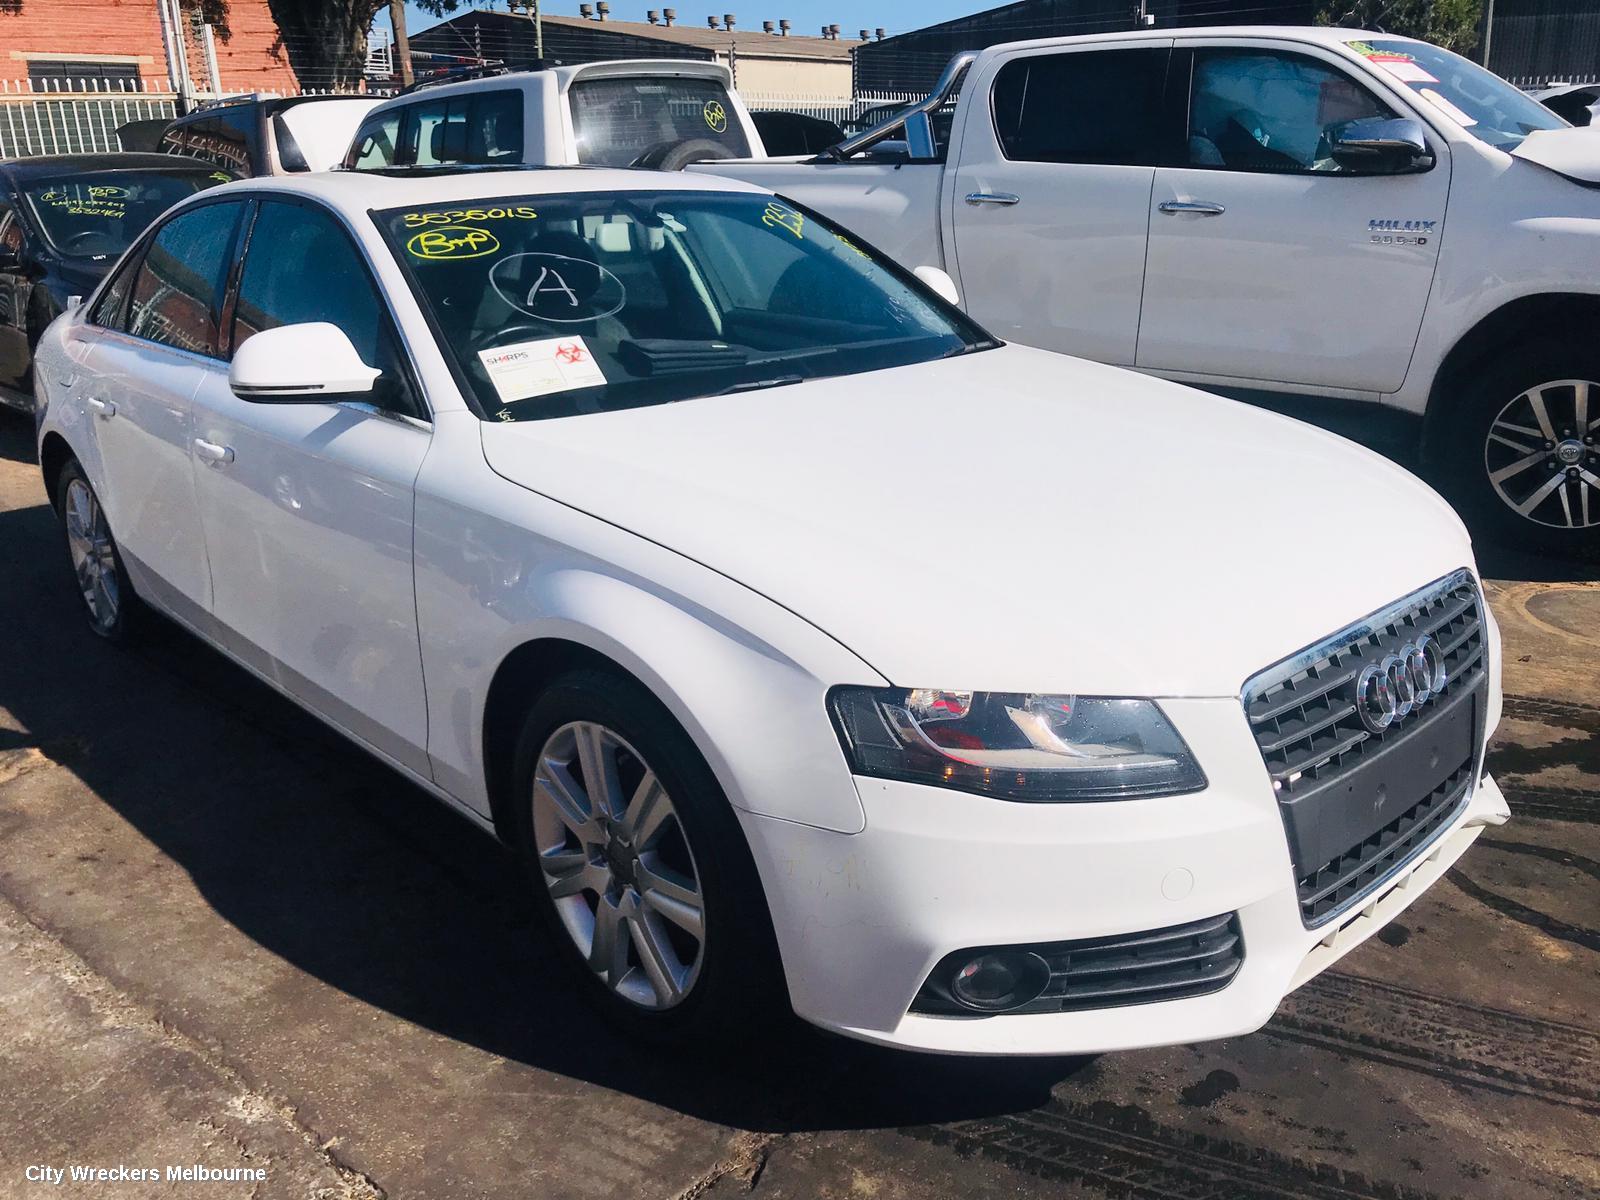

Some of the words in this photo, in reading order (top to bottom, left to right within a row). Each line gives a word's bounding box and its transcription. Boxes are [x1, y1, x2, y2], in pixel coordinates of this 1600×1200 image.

[1368, 219, 1437, 233] HILUX
[526, 266, 578, 307] A
[486, 351, 529, 365] SHARPS
